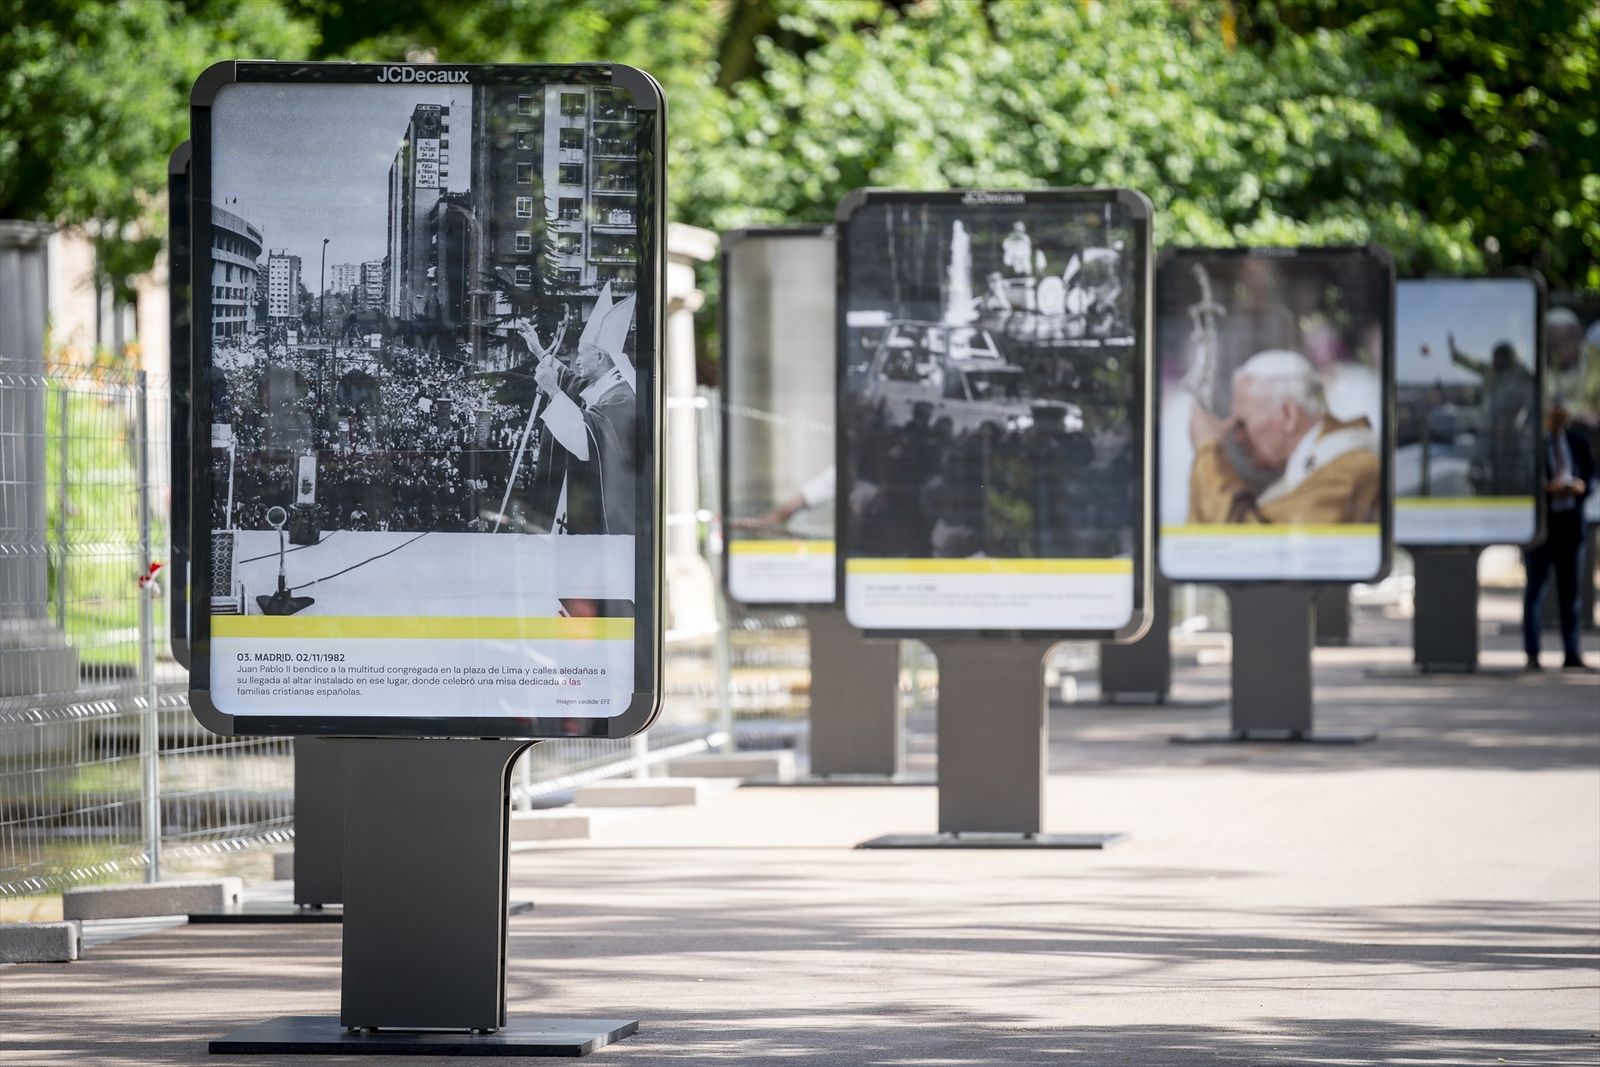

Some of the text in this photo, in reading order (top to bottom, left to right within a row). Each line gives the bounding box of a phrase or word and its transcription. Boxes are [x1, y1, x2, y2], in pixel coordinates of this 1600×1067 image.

[377, 66, 470, 83] JCDecaux
[236, 653, 345, 662] 03. MADRID. 02/11/1982
[236, 665, 258, 673] Juan
[260, 665, 284, 673] Pablo
[286, 665, 291, 673] II
[293, 665, 329, 673] bendice
[338, 665, 346, 673] la
[348, 665, 385, 673] multitud
[387, 666, 439, 675] congregada
[463, 666, 486, 675] plaza
[488, 666, 500, 674] de
[502, 666, 523, 674] Lima
[532, 666, 557, 675] calles
[560, 667, 598, 675] aledañas
[249, 676, 281, 686] llegada
[386, 677, 410, 686] lugar,
[236, 687, 362, 697] familias cristianas españolas.
